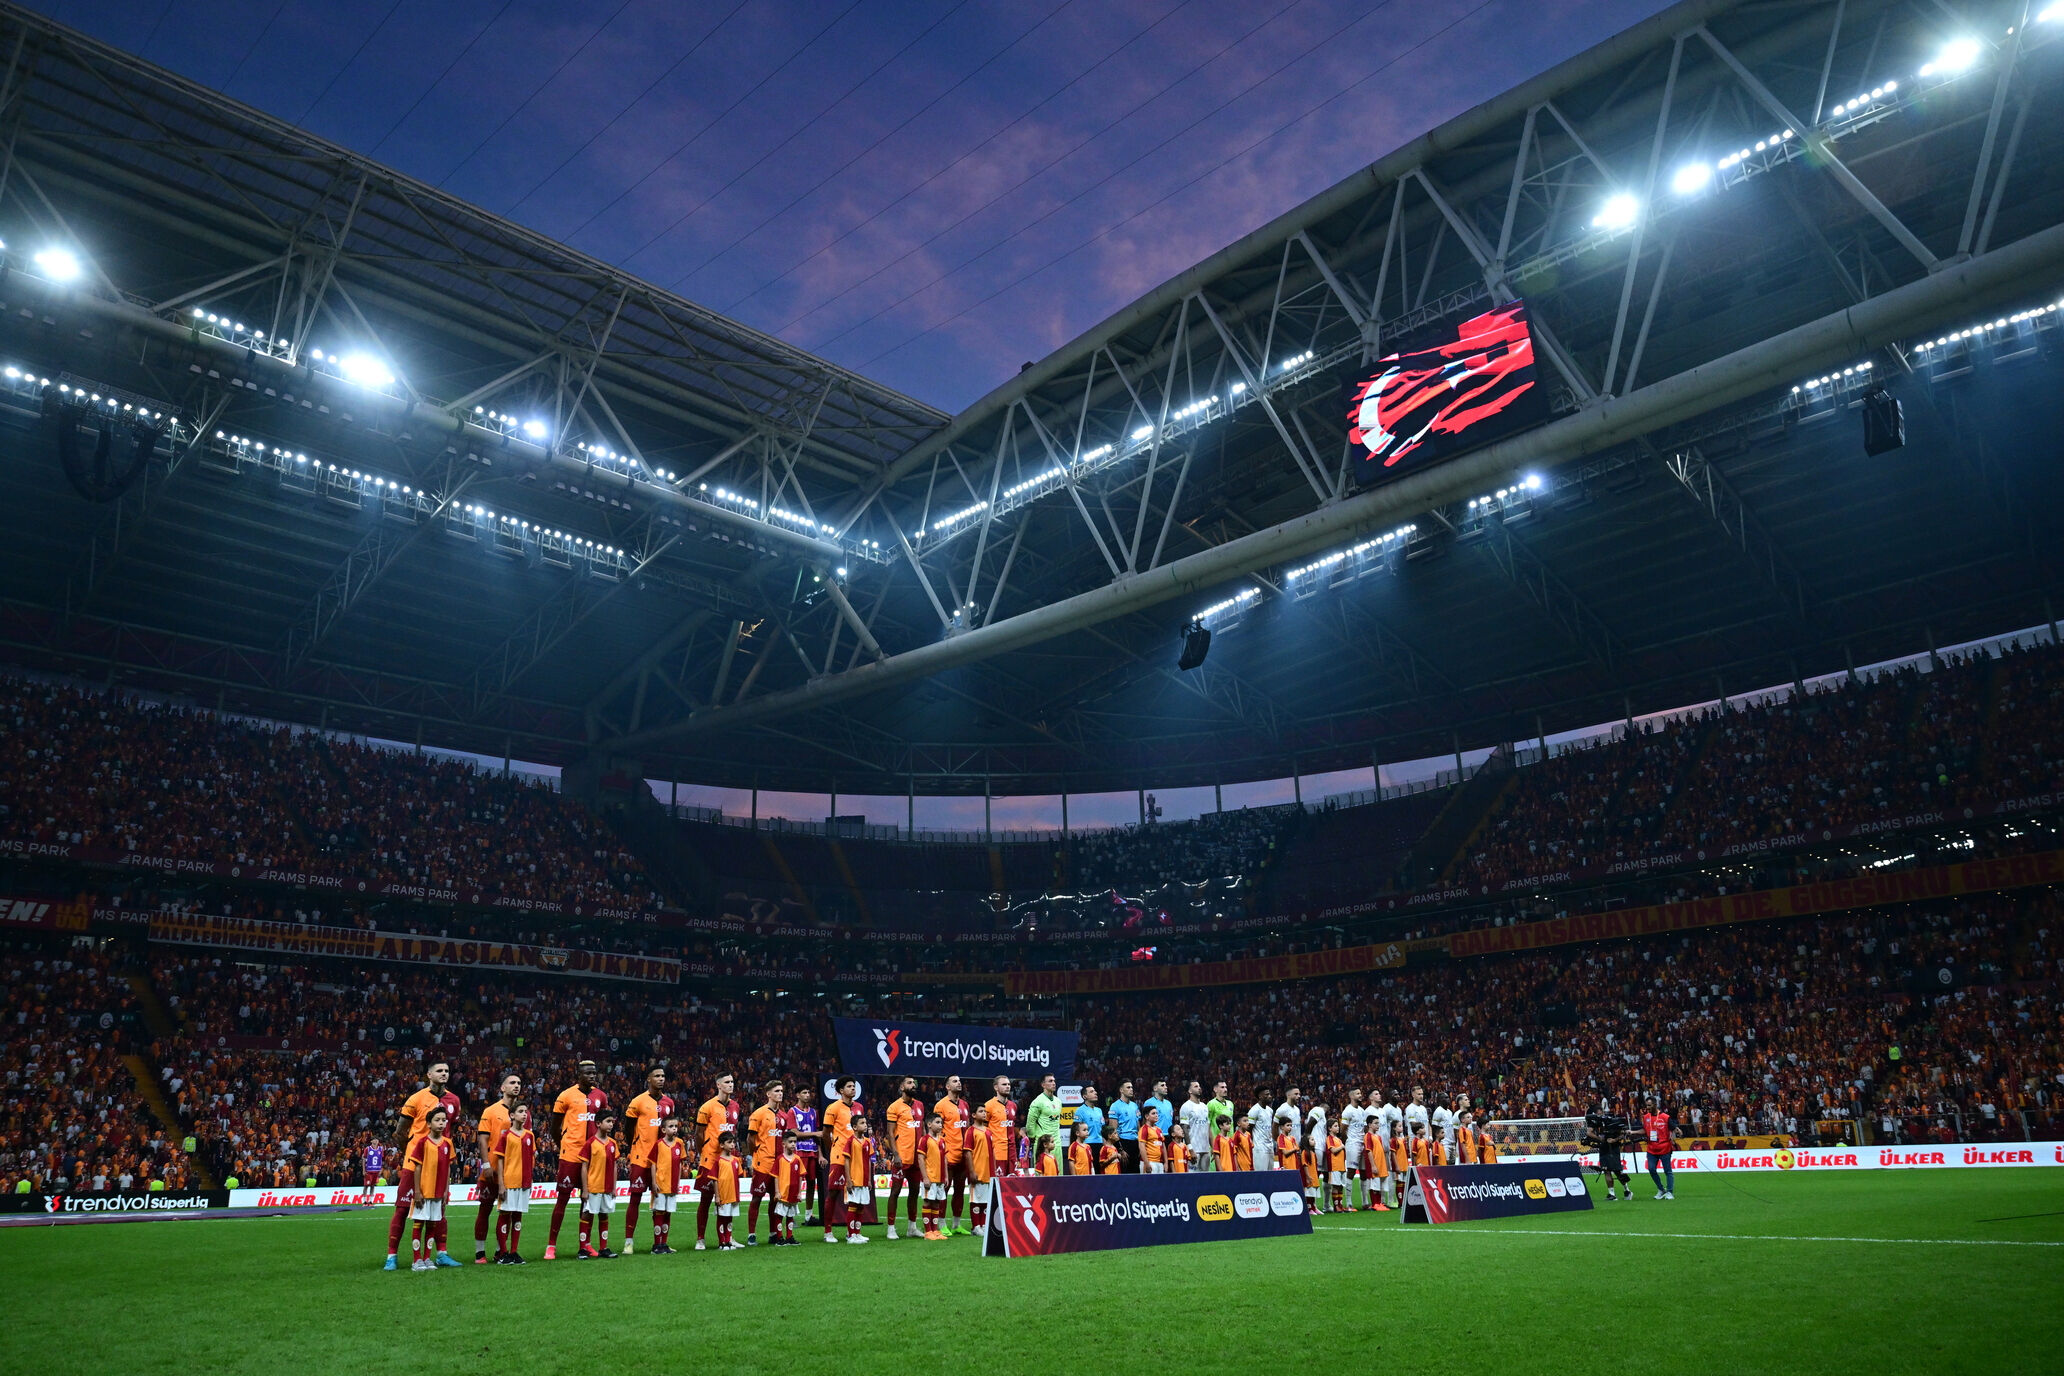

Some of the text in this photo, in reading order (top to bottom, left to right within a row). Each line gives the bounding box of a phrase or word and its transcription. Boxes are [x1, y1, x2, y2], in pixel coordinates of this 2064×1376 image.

[2006, 794, 2052, 811] RAMS
[1860, 811, 1944, 834] RAMS PARK
[28, 842, 69, 857] PARK
[1731, 833, 1806, 855] RAMS PARK
[131, 854, 215, 874] RAMS PARK
[1615, 853, 1682, 873] RAMS PARK
[268, 870, 343, 888] RAMS PARK
[1509, 871, 1570, 889] RAMS PARK
[392, 884, 458, 901] RAMS PARK
[1414, 885, 1469, 905] RAMS PARK
[502, 897, 562, 912] RAMS PARK
[120, 911, 149, 924] PAR
[602, 907, 657, 923] RAMS PRK
[377, 937, 538, 966] ALPASLAN
[690, 963, 715, 974] PARK
[904, 1036, 986, 1064] trendyol
[372, 1156, 378, 1166] 6
[1716, 1152, 1774, 1169] ÜLKER
[1797, 1150, 1858, 1168] ÜLKER
[1879, 1148, 1946, 1167] ÜLKER
[1963, 1146, 2035, 1165] ÜLKER
[257, 1190, 317, 1207] ÜLKER
[530, 1186, 578, 1200] ÜLKR
[1447, 1181, 1491, 1202] trendyol
[64, 1193, 150, 1212] trendyol
[1239, 1196, 1263, 1207] trendyol
[1052, 1197, 1132, 1226] trendyol
